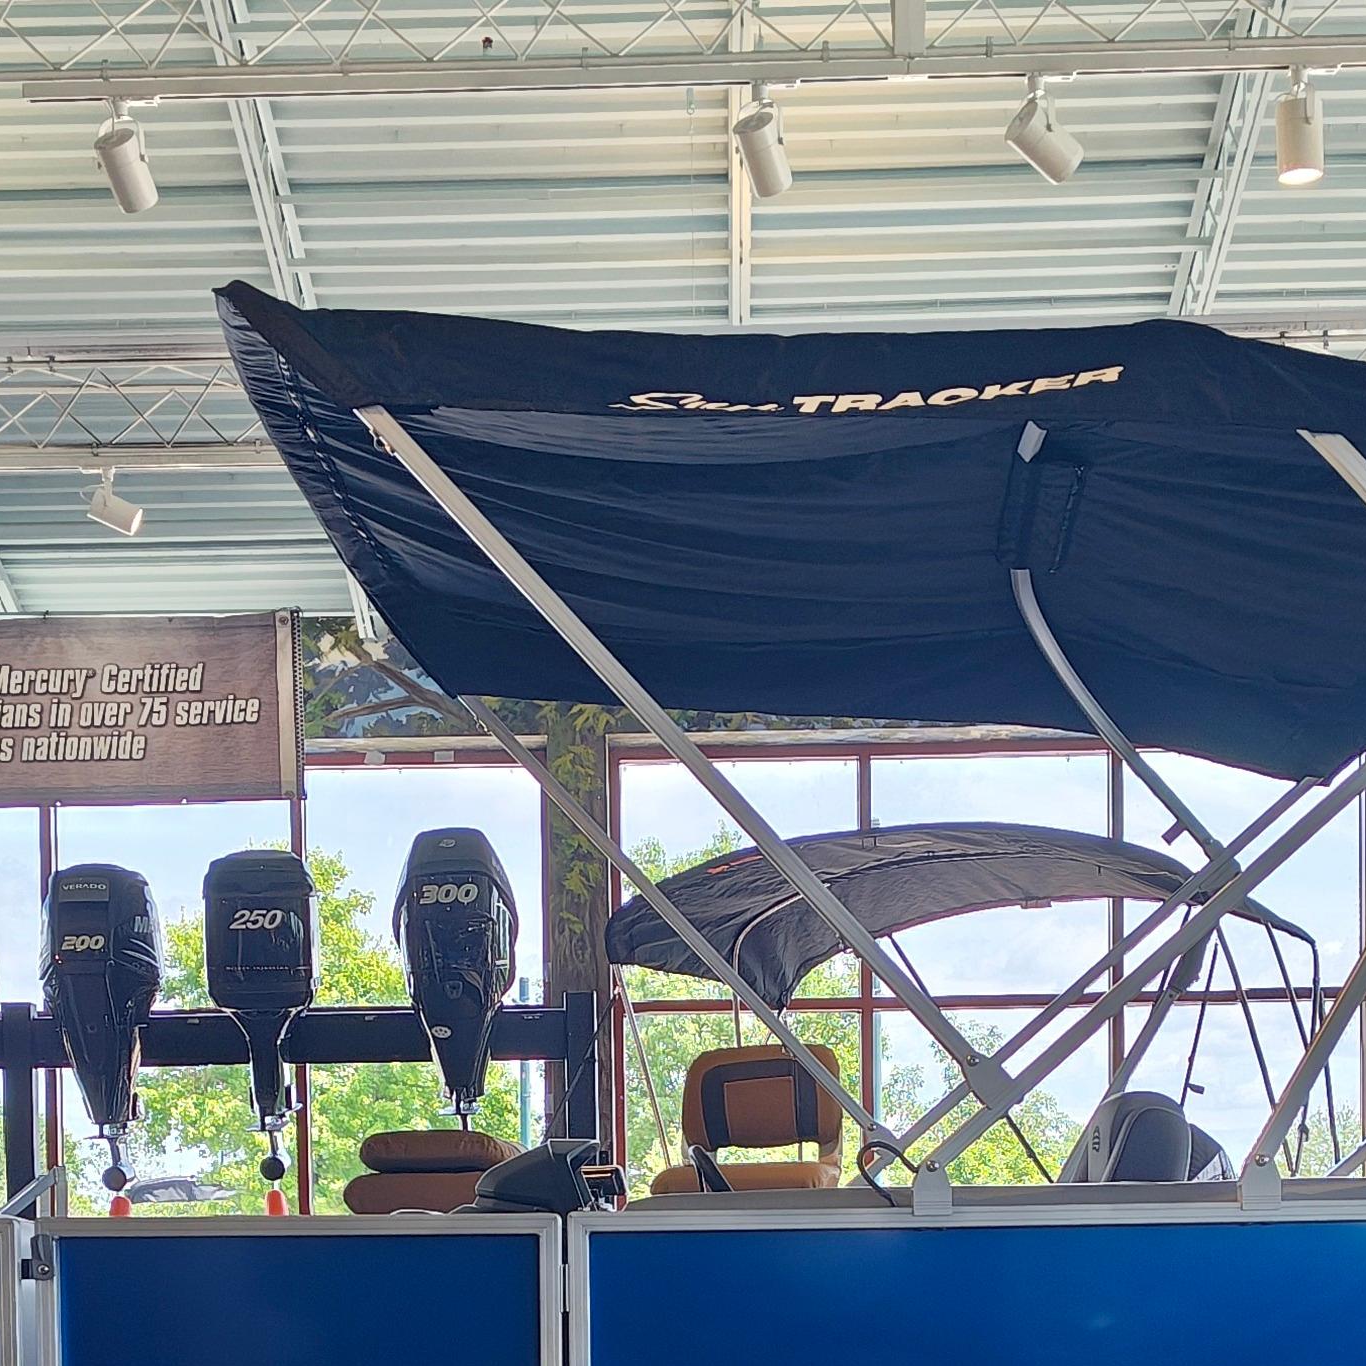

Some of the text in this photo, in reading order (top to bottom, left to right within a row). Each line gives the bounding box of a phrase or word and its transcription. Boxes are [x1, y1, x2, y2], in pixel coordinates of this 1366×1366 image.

[792, 366, 1124, 413] TRACKER
[101, 662, 203, 694] Certified
[49, 699, 72, 728] in
[79, 701, 131, 727] over
[137, 696, 168, 726] 75
[175, 694, 260, 726] service
[21, 731, 146, 762] nationwide
[419, 883, 479, 905] 300
[229, 909, 284, 930] 250
[61, 935, 105, 951] 200
